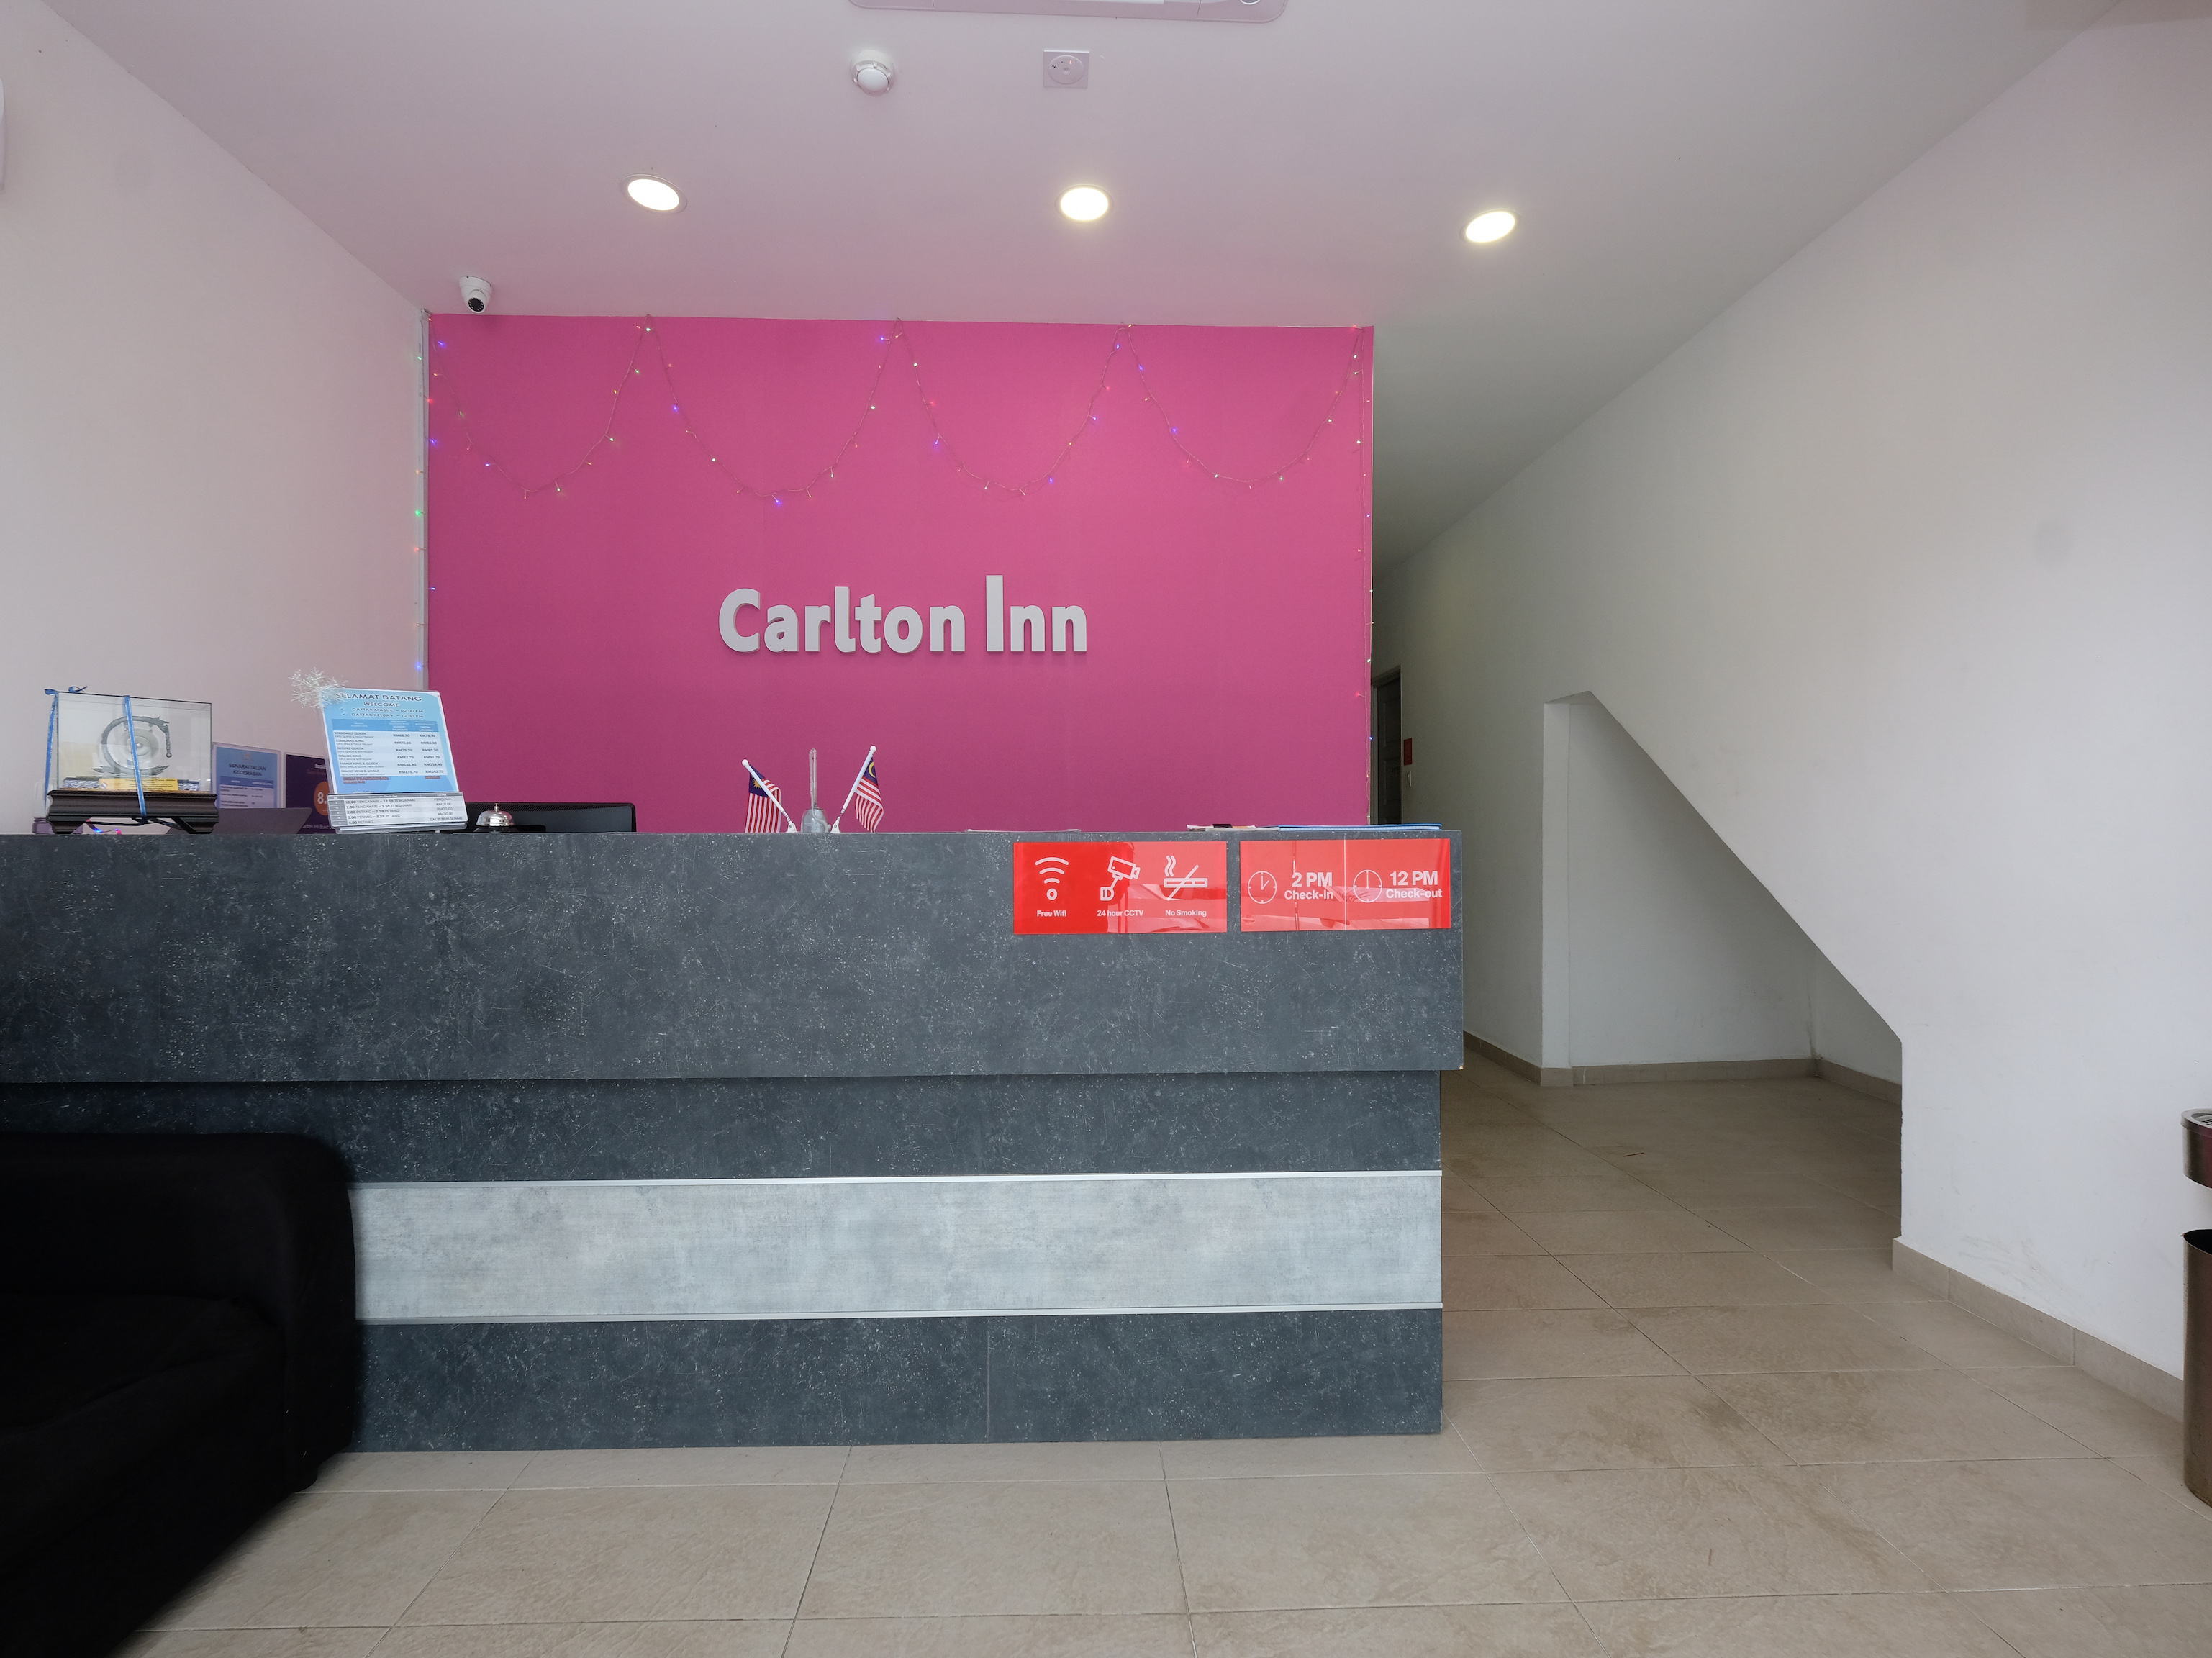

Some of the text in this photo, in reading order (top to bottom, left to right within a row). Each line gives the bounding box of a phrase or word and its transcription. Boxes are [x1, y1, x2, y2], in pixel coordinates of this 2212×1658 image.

[718, 575, 1087, 653] Carlton Inn
[1292, 872, 1332, 887] 2 PM
[1390, 871, 1438, 886] 12 PM
[1284, 889, 1333, 900] Check-in
[1385, 888, 1443, 899] Check-out
